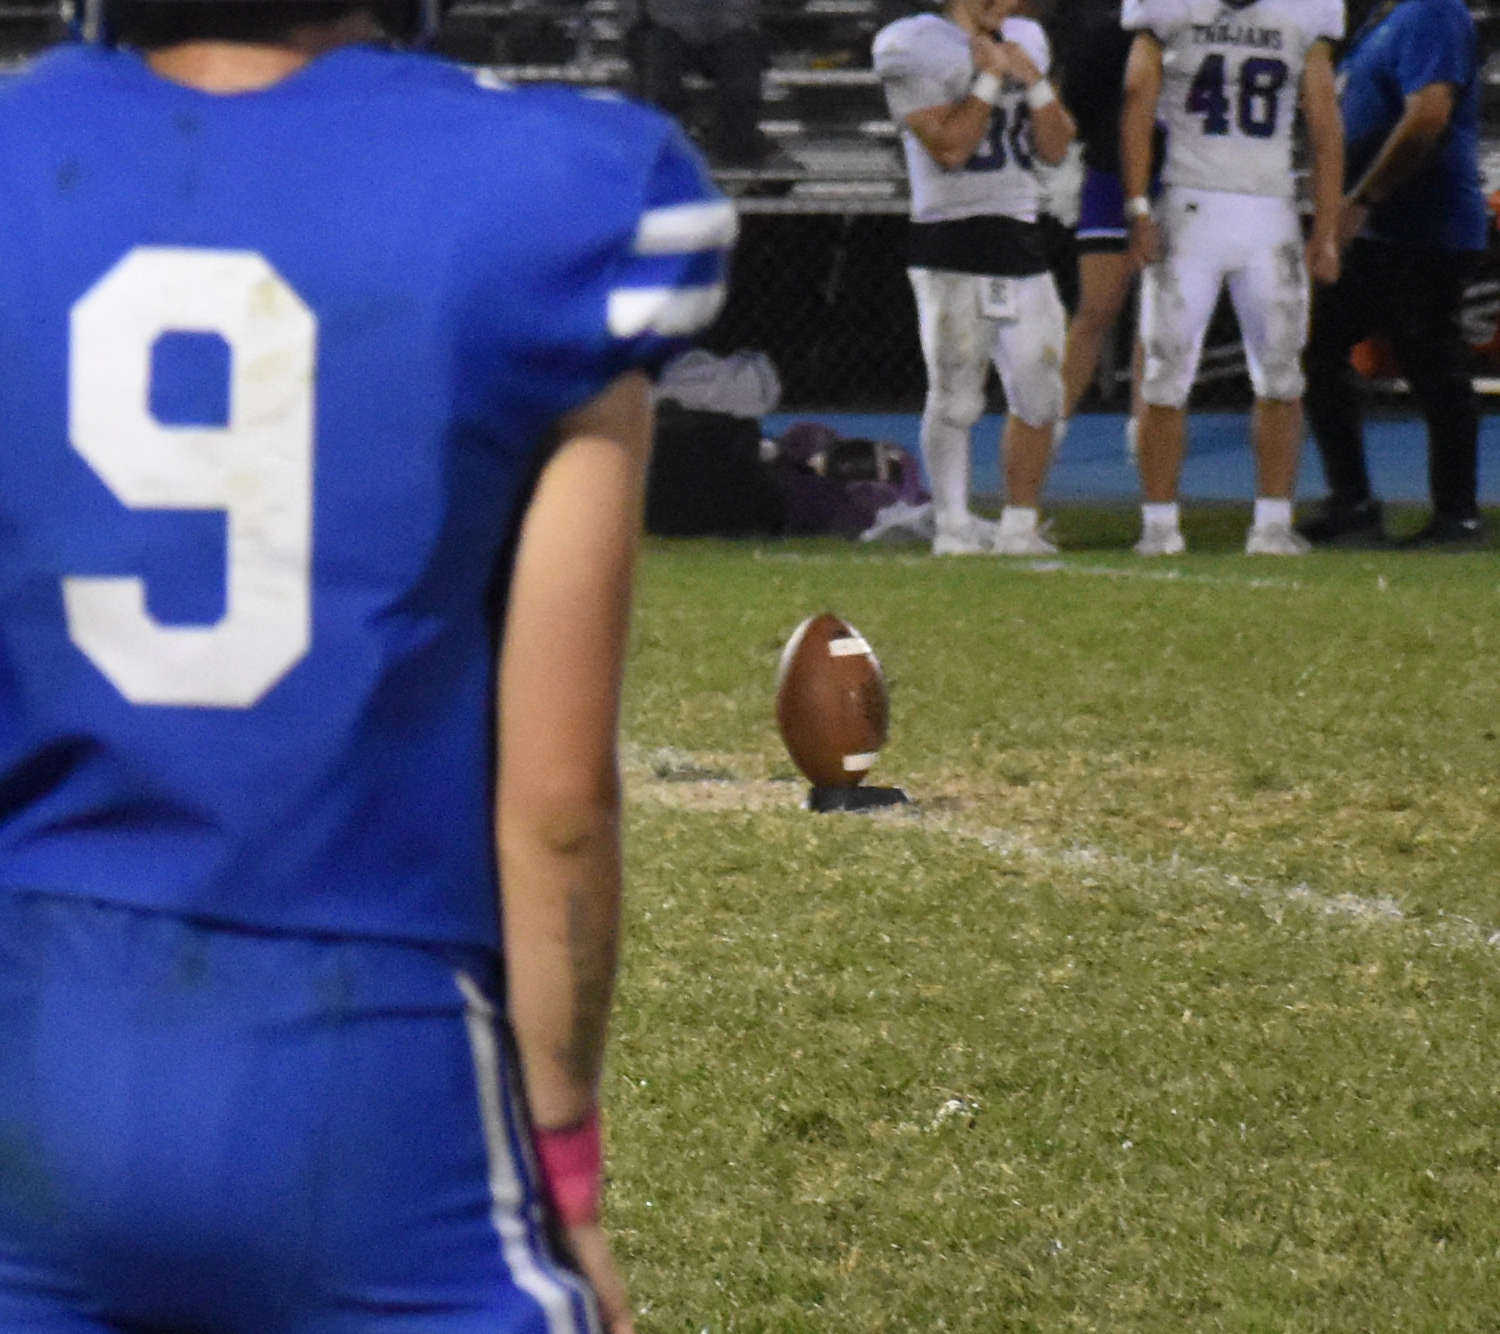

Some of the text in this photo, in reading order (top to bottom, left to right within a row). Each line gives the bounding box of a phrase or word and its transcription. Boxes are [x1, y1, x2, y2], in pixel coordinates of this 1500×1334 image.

[1191, 24, 1283, 50] TROJANS
[1185, 52, 1289, 138] 48
[63, 245, 319, 710] 9
